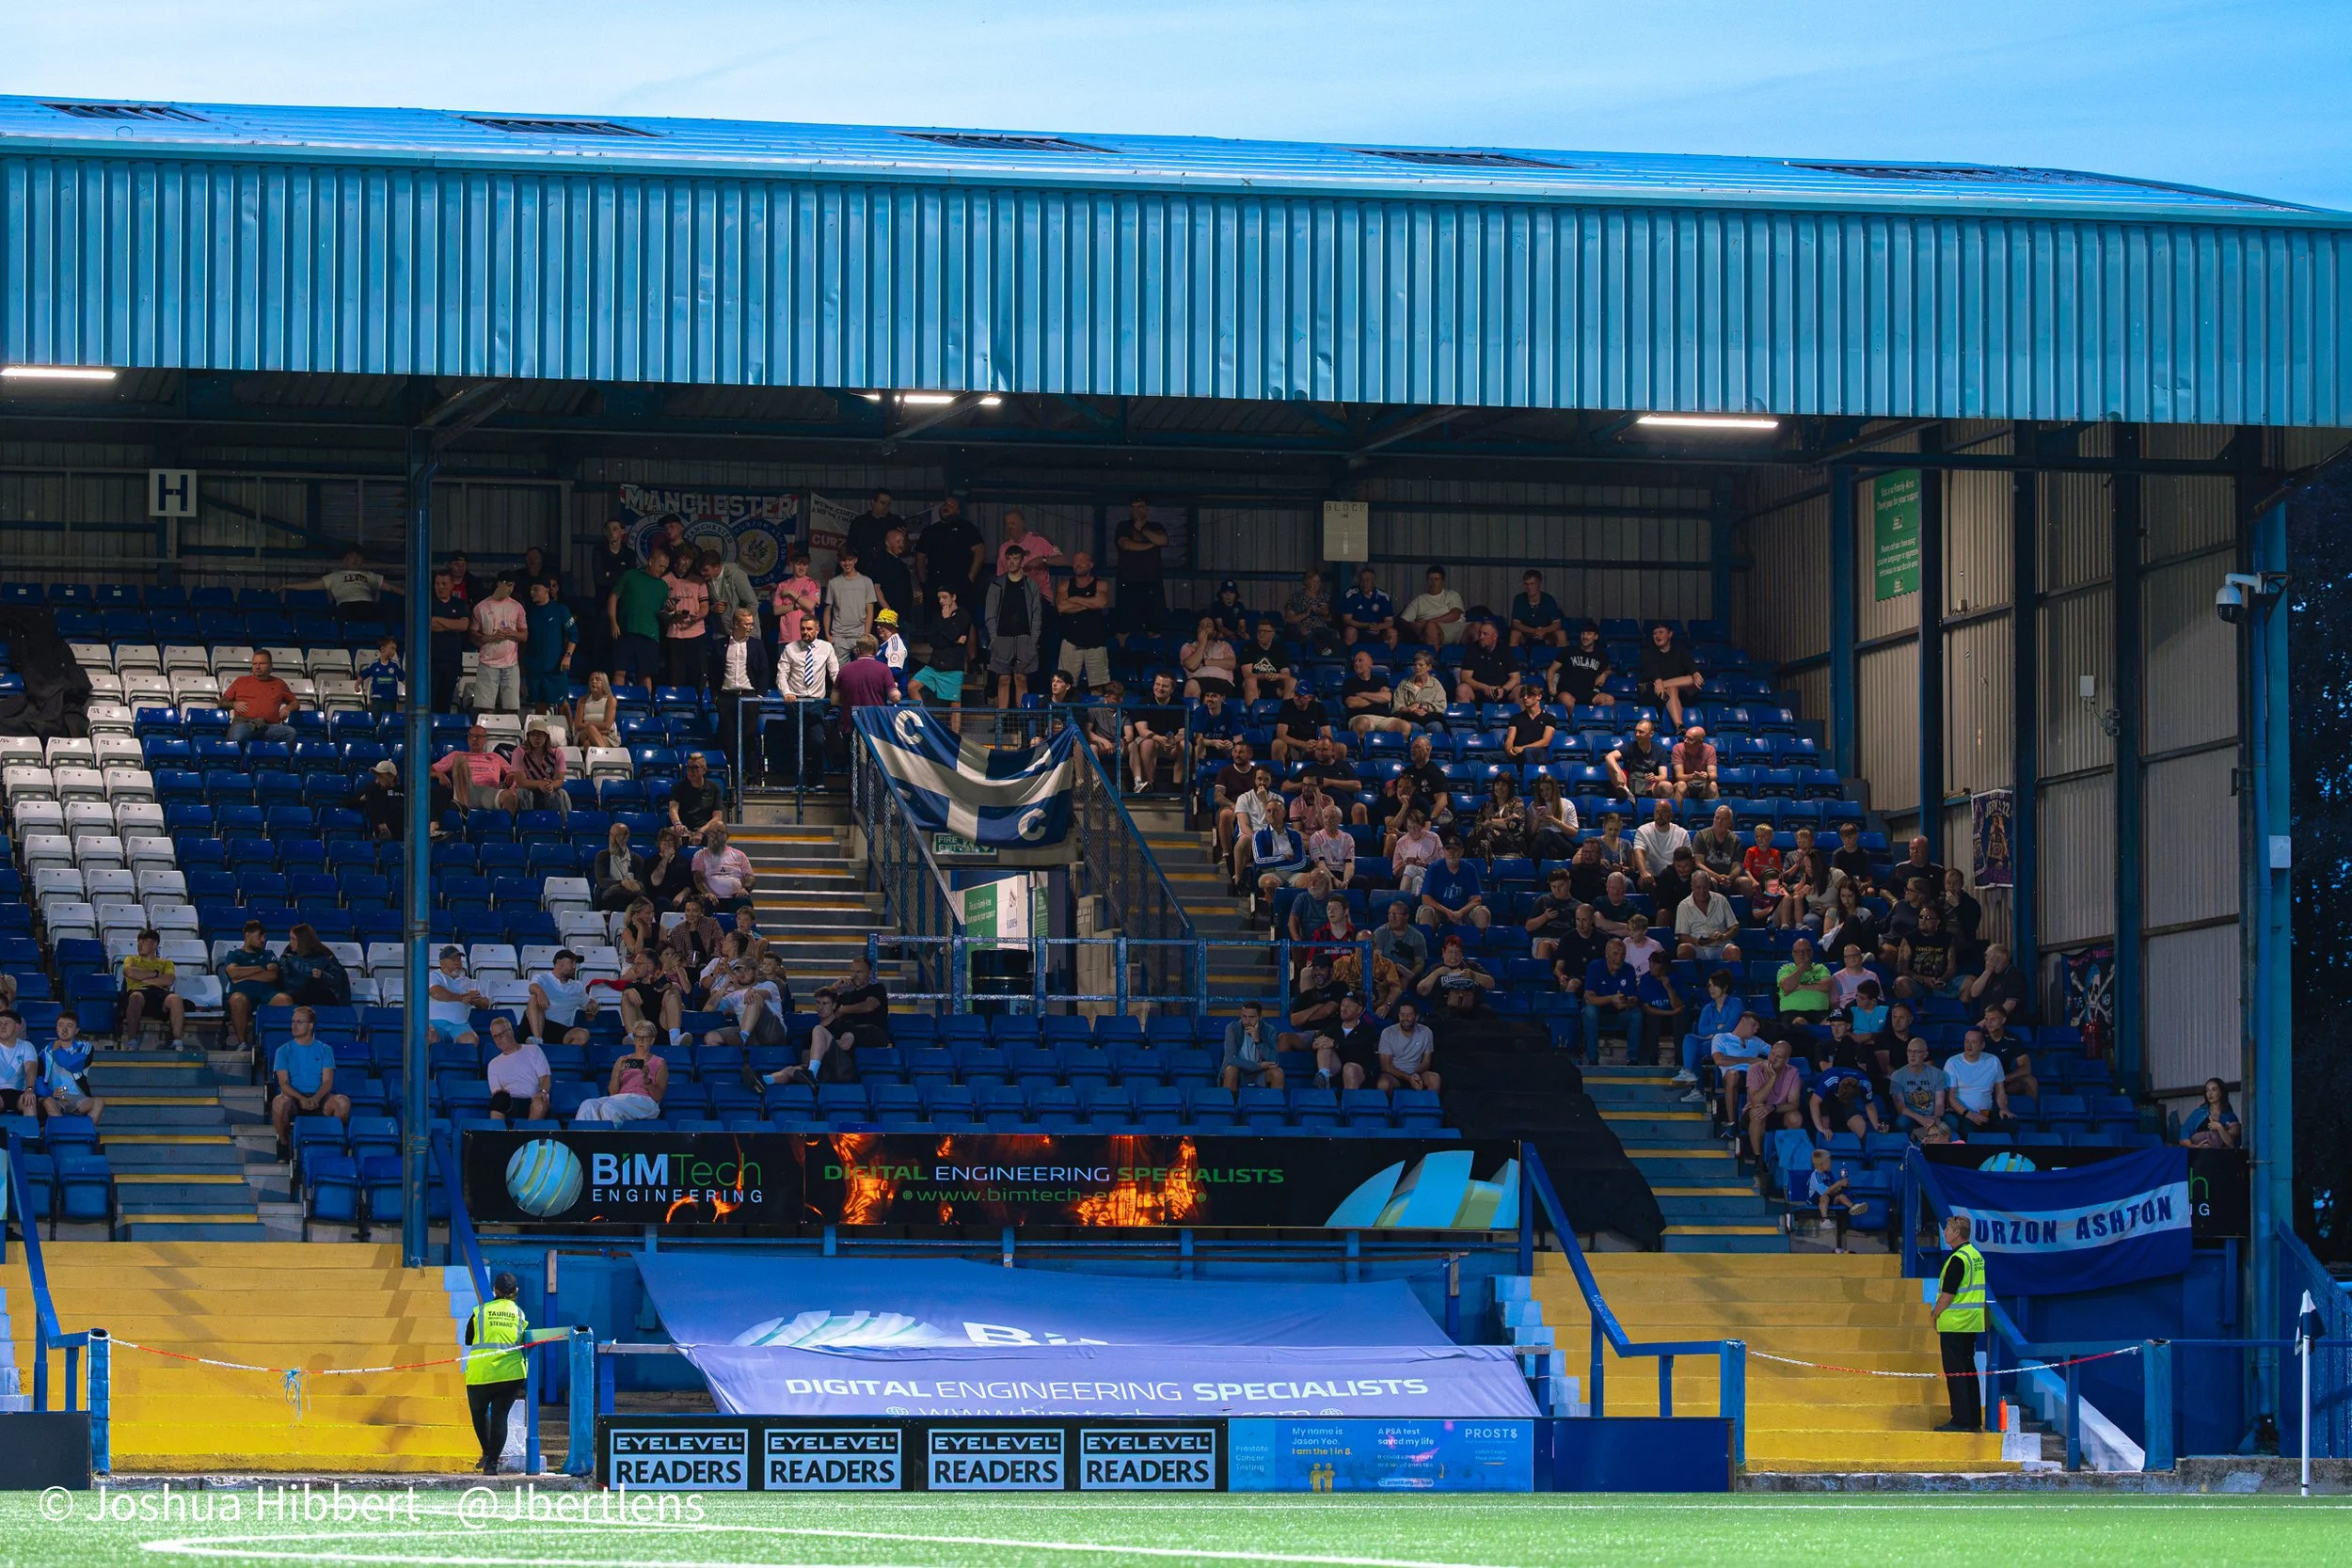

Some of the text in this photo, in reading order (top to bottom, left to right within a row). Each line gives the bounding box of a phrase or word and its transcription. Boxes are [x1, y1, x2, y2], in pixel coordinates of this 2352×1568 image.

[158, 473, 188, 513] H
[624, 485, 796, 519] MANCHESTER
[812, 533, 847, 549] CURZ
[1570, 656, 1600, 671] MILANO
[895, 709, 924, 745] C
[1018, 808, 1046, 841] C
[938, 835, 958, 844] FIRE
[938, 844, 958, 852] EXIT
[824, 1165, 1284, 1183] DIGITAL ENGINEERING SPECIALISTS
[593, 1189, 763, 1203] ENGINEERING
[1977, 1196, 2172, 1243] URZON ASHTON
[488, 1310, 516, 1319] TAURUS
[785, 1378, 1429, 1402] DIGITAL ENGINEERING SPECIALISTS
[1292, 1427, 1305, 1436] My
[1335, 1427, 1343, 1435] is
[1465, 1428, 1518, 1438] PROST8
[1406, 1438, 1419, 1447] my
[616, 1460, 742, 1483] READERS
[771, 1460, 895, 1483] READERS
[935, 1460, 1057, 1483] READERS
[1087, 1460, 1209, 1483] READERS
